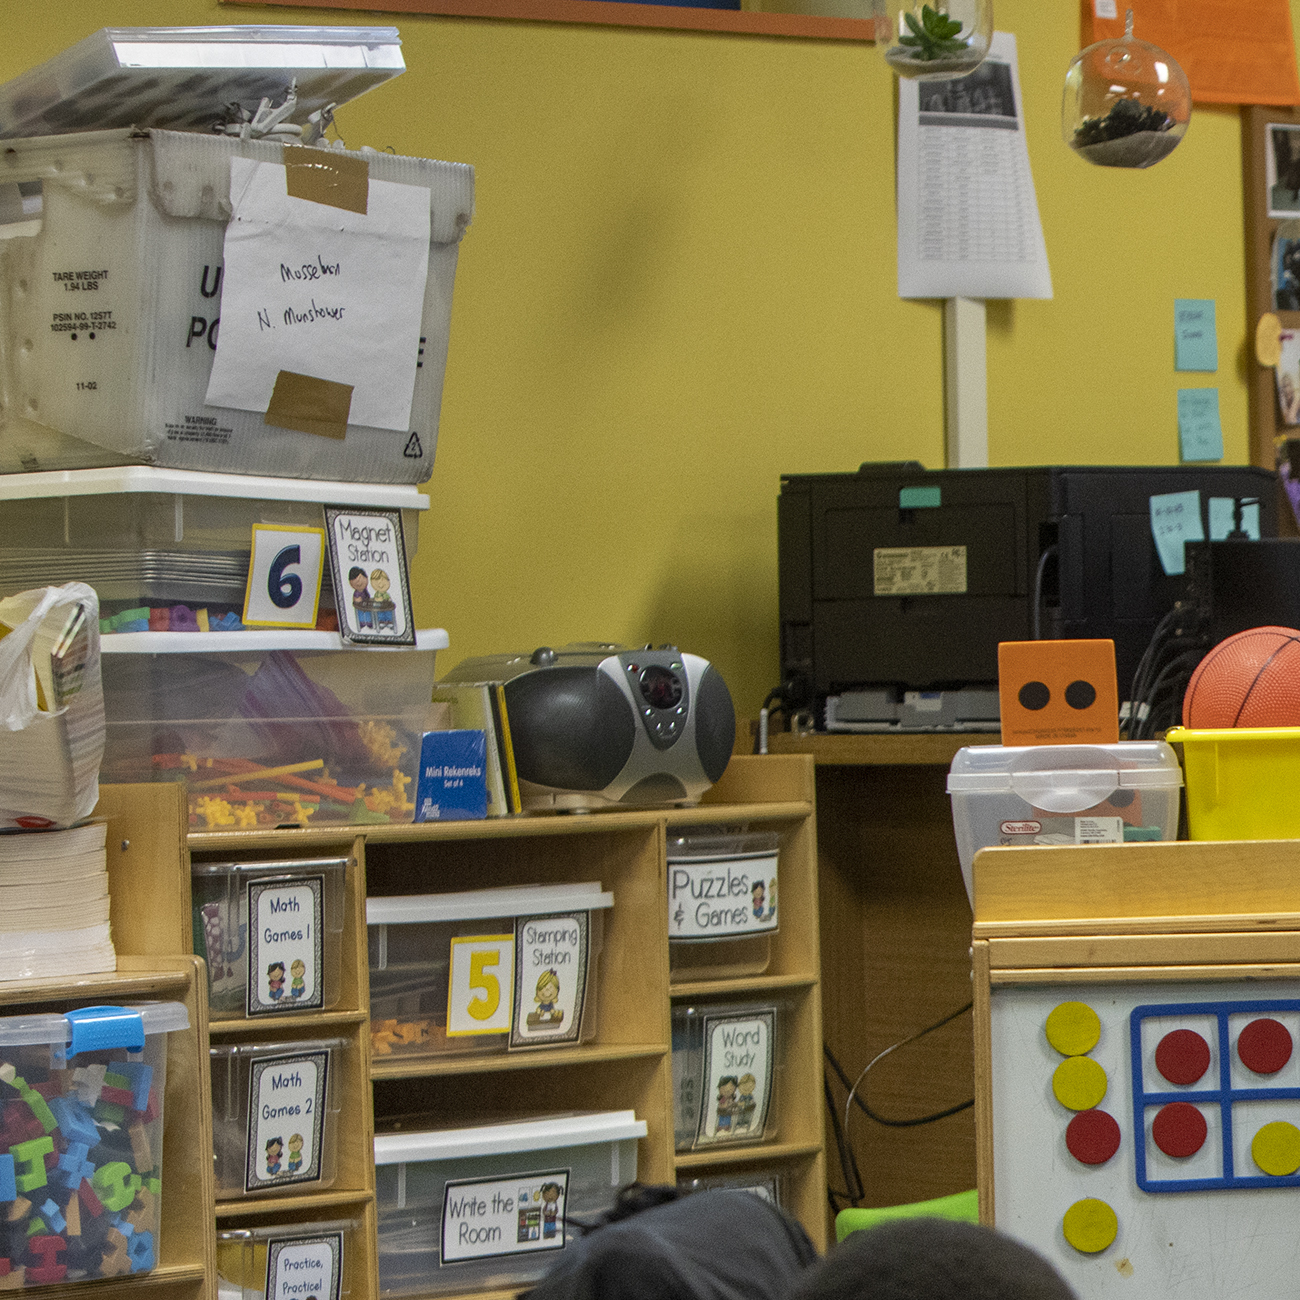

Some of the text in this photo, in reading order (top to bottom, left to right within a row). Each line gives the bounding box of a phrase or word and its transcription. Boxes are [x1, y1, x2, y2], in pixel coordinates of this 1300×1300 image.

[52, 270, 109, 282] TARE WEIGHT
[64, 281, 99, 291] 1.94 LBS
[53, 311, 113, 322] PSIN NO. 1257T
[76, 382, 97, 391] 11-02
[338, 518, 392, 547] Magnet
[348, 543, 390, 563] Station
[267, 544, 303, 609] 6
[425, 765, 482, 778] Mini Rekenreks
[1003, 823, 1039, 833] Sterilite
[672, 867, 749, 900] Puzzles
[269, 896, 300, 915] Math
[673, 901, 748, 929] & Games
[264, 923, 310, 944] Games 1
[526, 926, 578, 947] Stamping
[532, 948, 571, 966] Station
[467, 949, 500, 1021] 5
[721, 1023, 761, 1048] Word
[724, 1048, 756, 1068] Study
[271, 1071, 302, 1091] Math
[262, 1097, 313, 1120] Games 2
[449, 1191, 514, 1219] Write the
[458, 1221, 502, 1246] Room
[284, 1257, 323, 1272] Practice,
